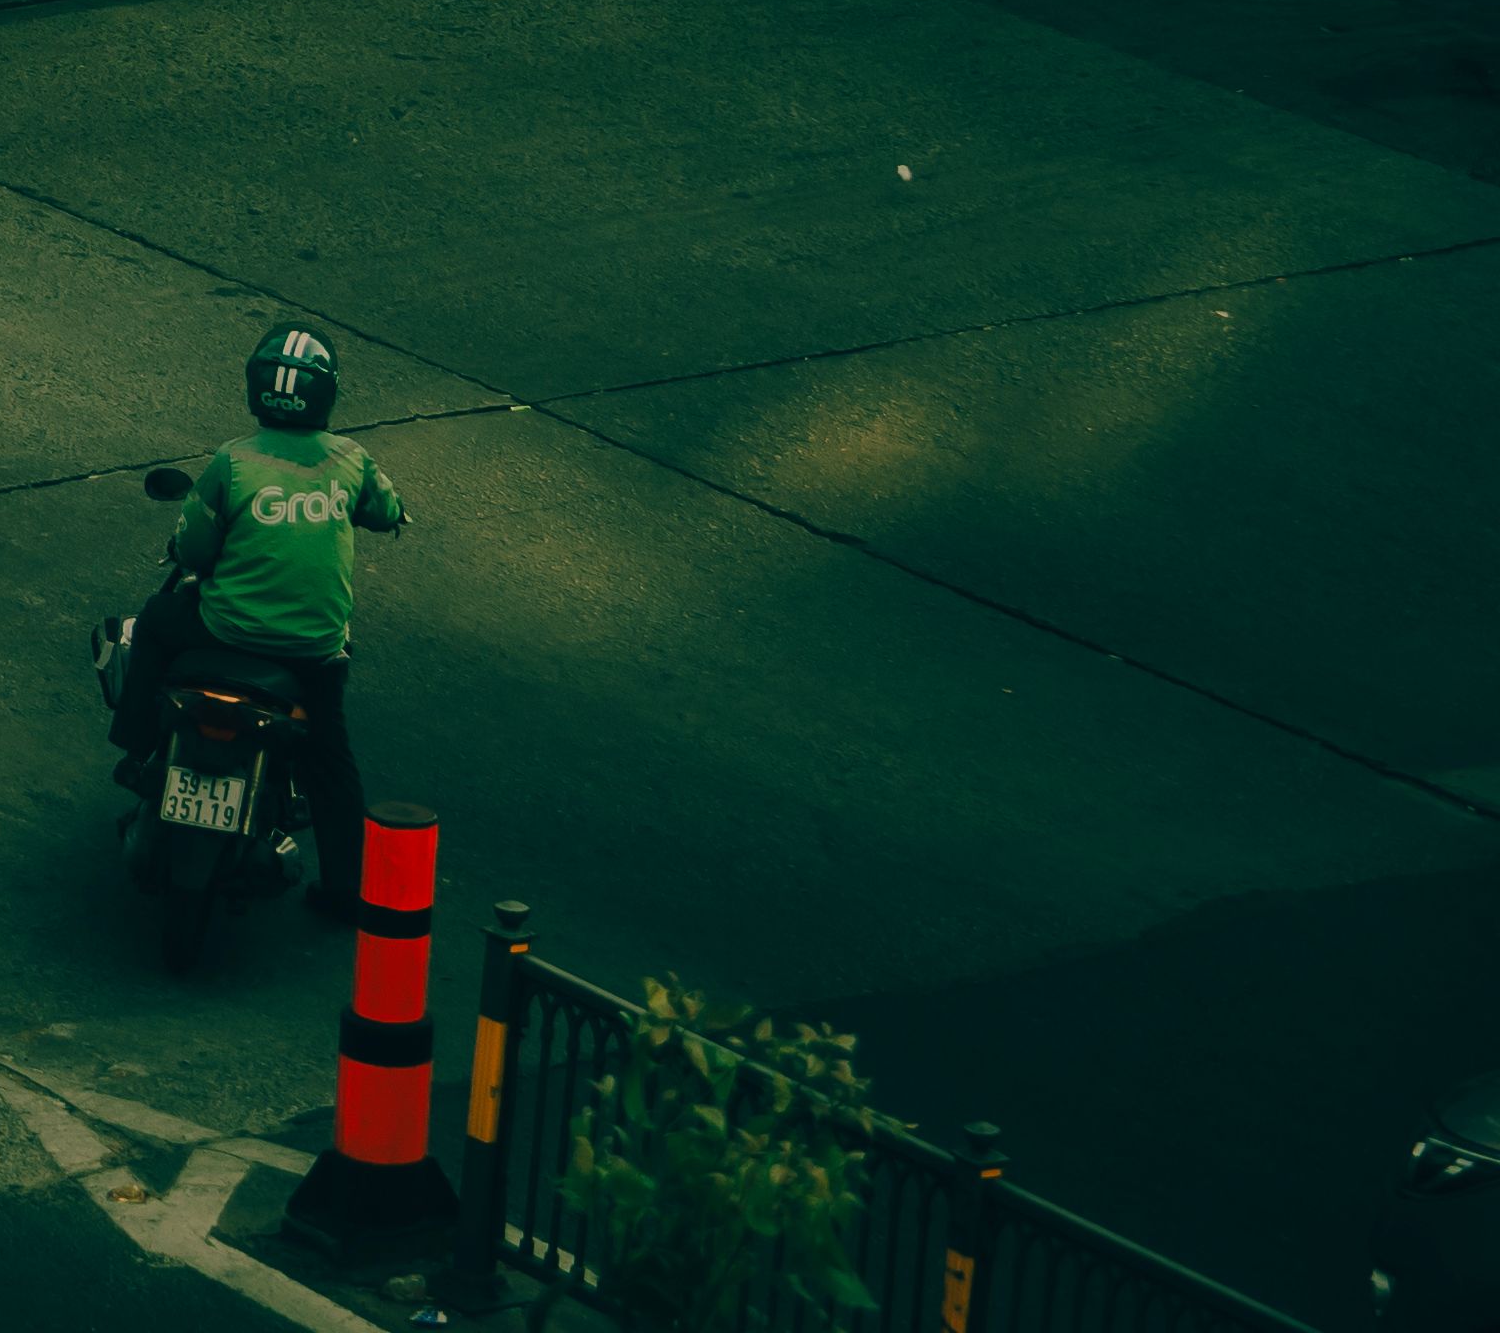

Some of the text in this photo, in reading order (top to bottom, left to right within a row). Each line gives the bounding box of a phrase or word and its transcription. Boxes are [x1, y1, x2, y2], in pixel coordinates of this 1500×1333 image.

[261, 392, 307, 411] Grab
[251, 479, 349, 526] Grab
[177, 771, 231, 802] 59-L1
[166, 795, 235, 827] 351.19
